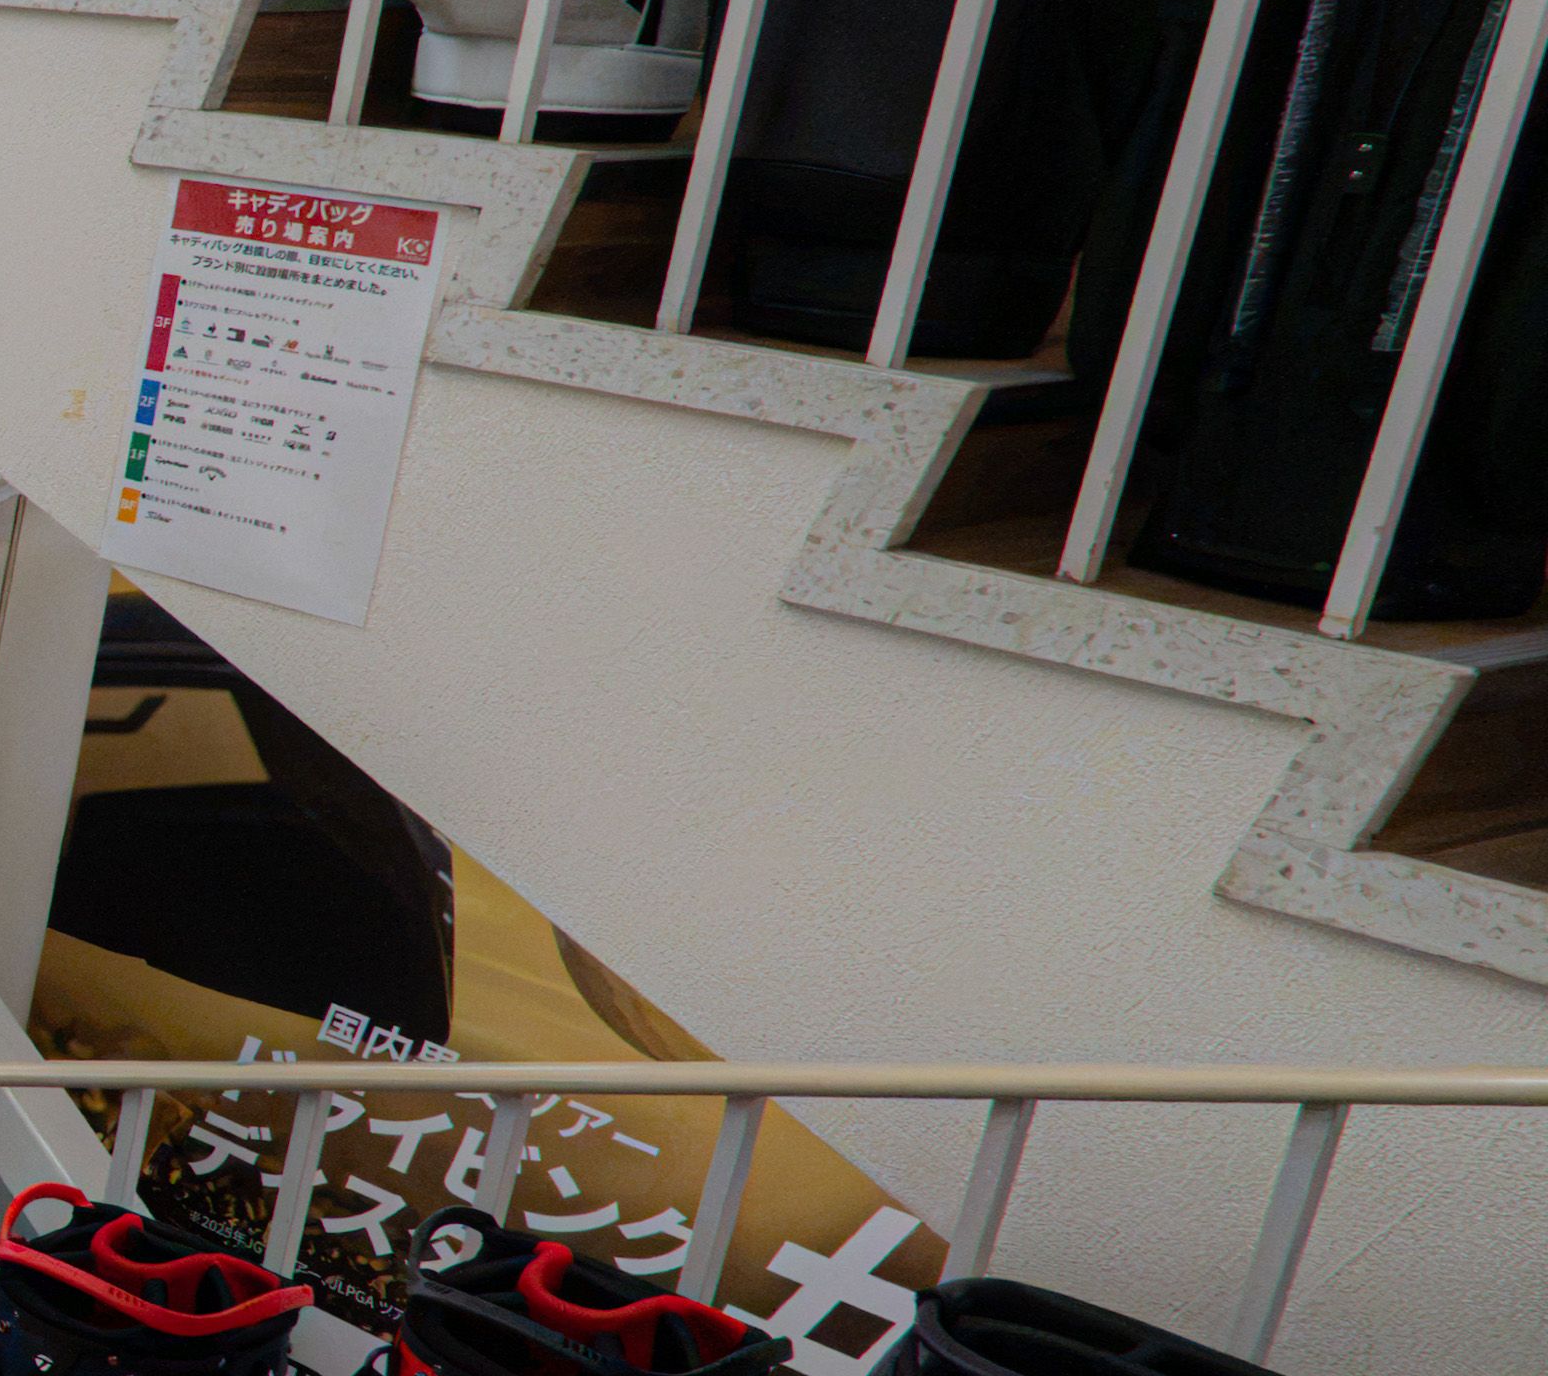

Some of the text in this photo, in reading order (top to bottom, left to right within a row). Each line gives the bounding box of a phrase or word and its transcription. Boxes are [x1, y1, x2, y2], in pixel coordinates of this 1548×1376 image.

[228, 189, 374, 226] キャディバッグ
[235, 215, 355, 250] 売り場案内
[155, 316, 173, 328] 3F
[140, 395, 155, 408] 2F
[129, 448, 146, 460] 1F
